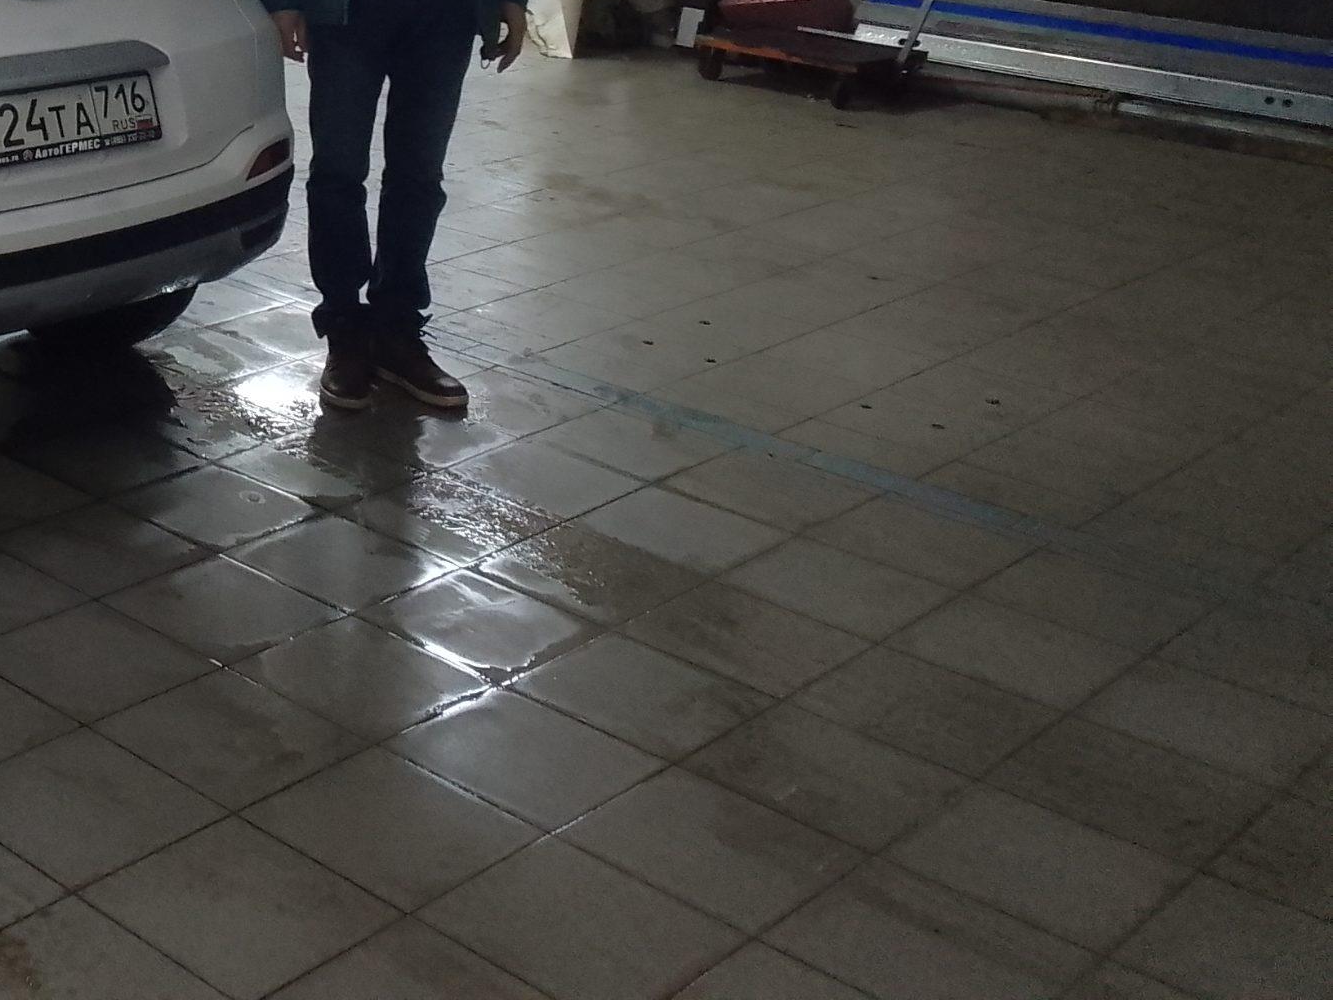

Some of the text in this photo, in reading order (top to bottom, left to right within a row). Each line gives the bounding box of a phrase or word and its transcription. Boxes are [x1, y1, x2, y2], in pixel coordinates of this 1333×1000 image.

[95, 81, 147, 119] 716
[112, 117, 136, 131] RUS
[35, 138, 101, 159] АвтоГЕРМЕС
